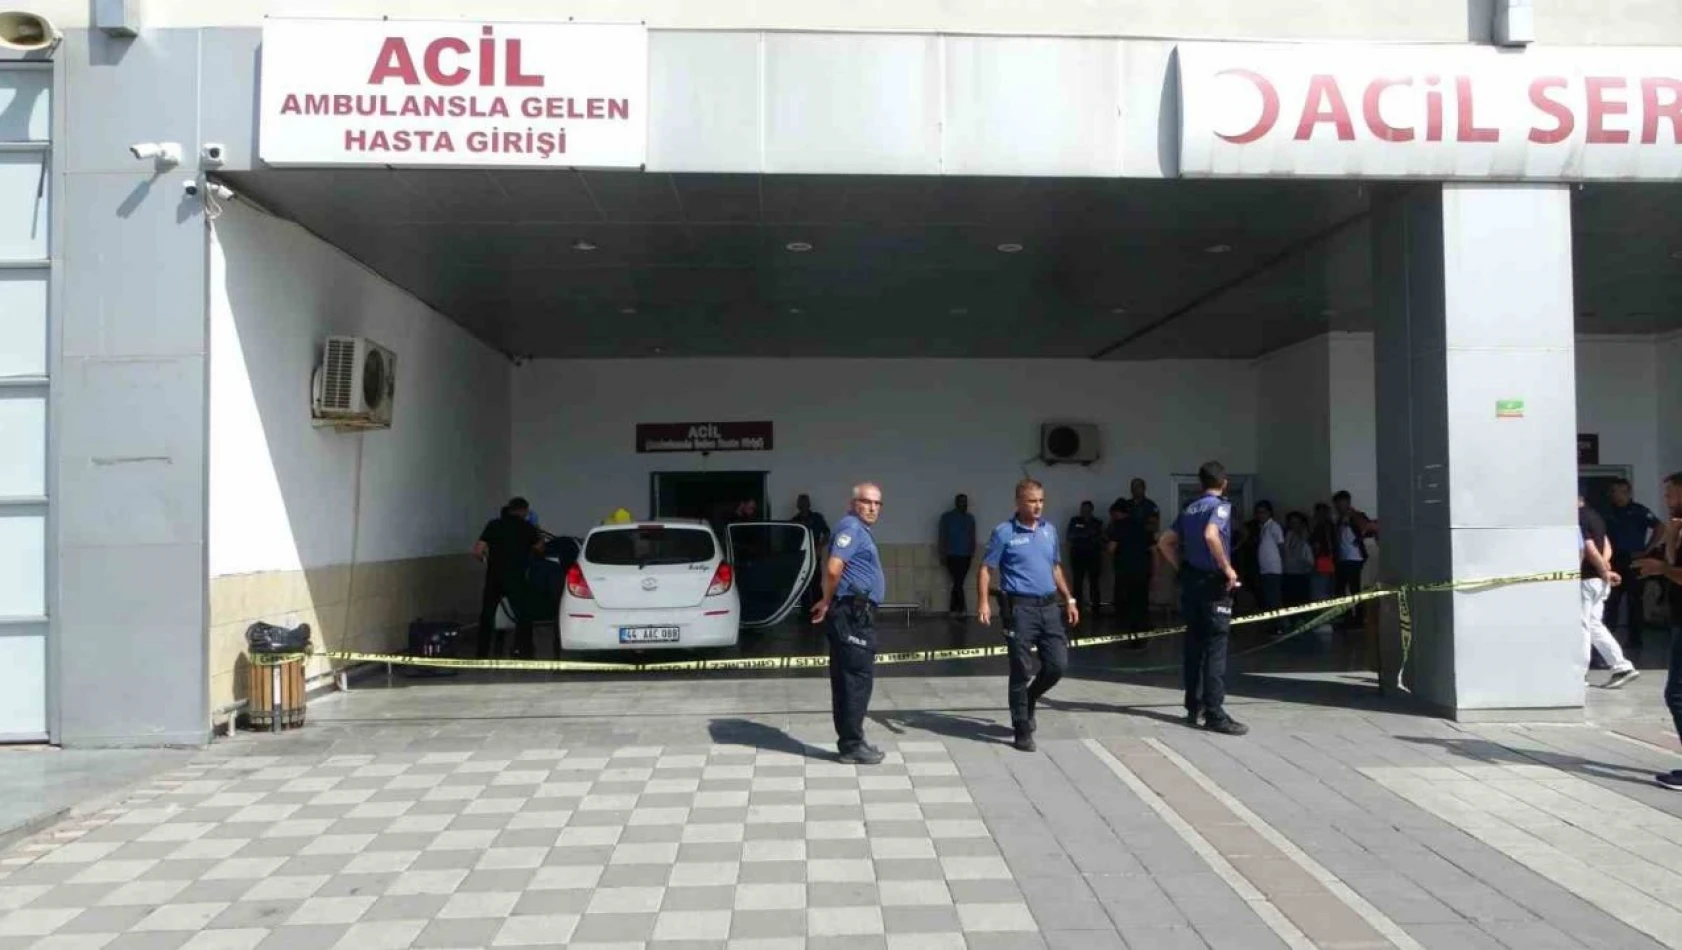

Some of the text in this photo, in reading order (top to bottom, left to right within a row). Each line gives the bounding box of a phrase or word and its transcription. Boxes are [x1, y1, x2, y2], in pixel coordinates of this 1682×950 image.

[368, 25, 545, 87] ACİL
[280, 94, 630, 120] AMBULANSLA GELEN
[1528, 76, 1682, 145] SER
[345, 127, 567, 159] HASTA GİRİŞİ
